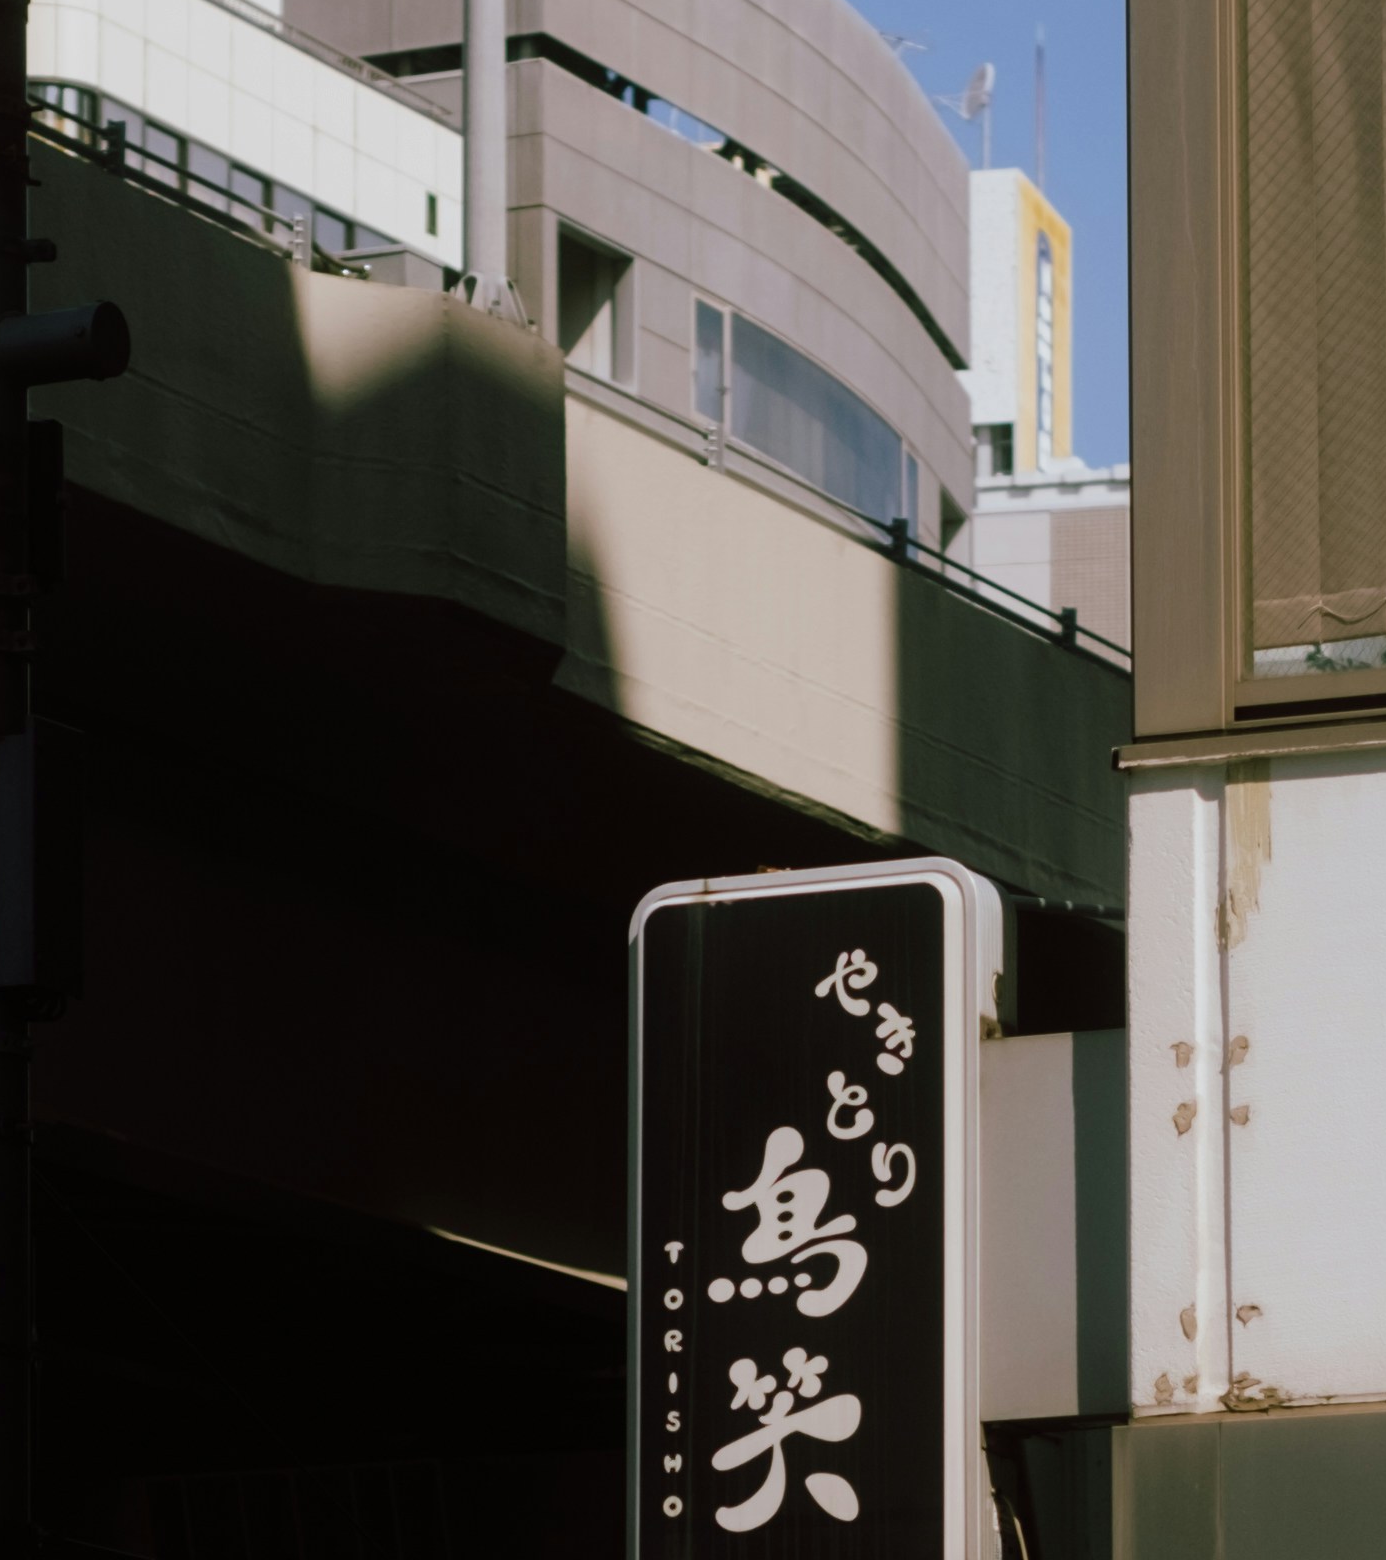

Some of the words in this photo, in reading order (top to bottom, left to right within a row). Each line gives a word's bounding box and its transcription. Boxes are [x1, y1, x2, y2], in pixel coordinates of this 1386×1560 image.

[815, 949, 916, 1207] やきとり
[664, 1241, 684, 1517] TORISHO
[708, 1126, 868, 1532] 鳥笑
